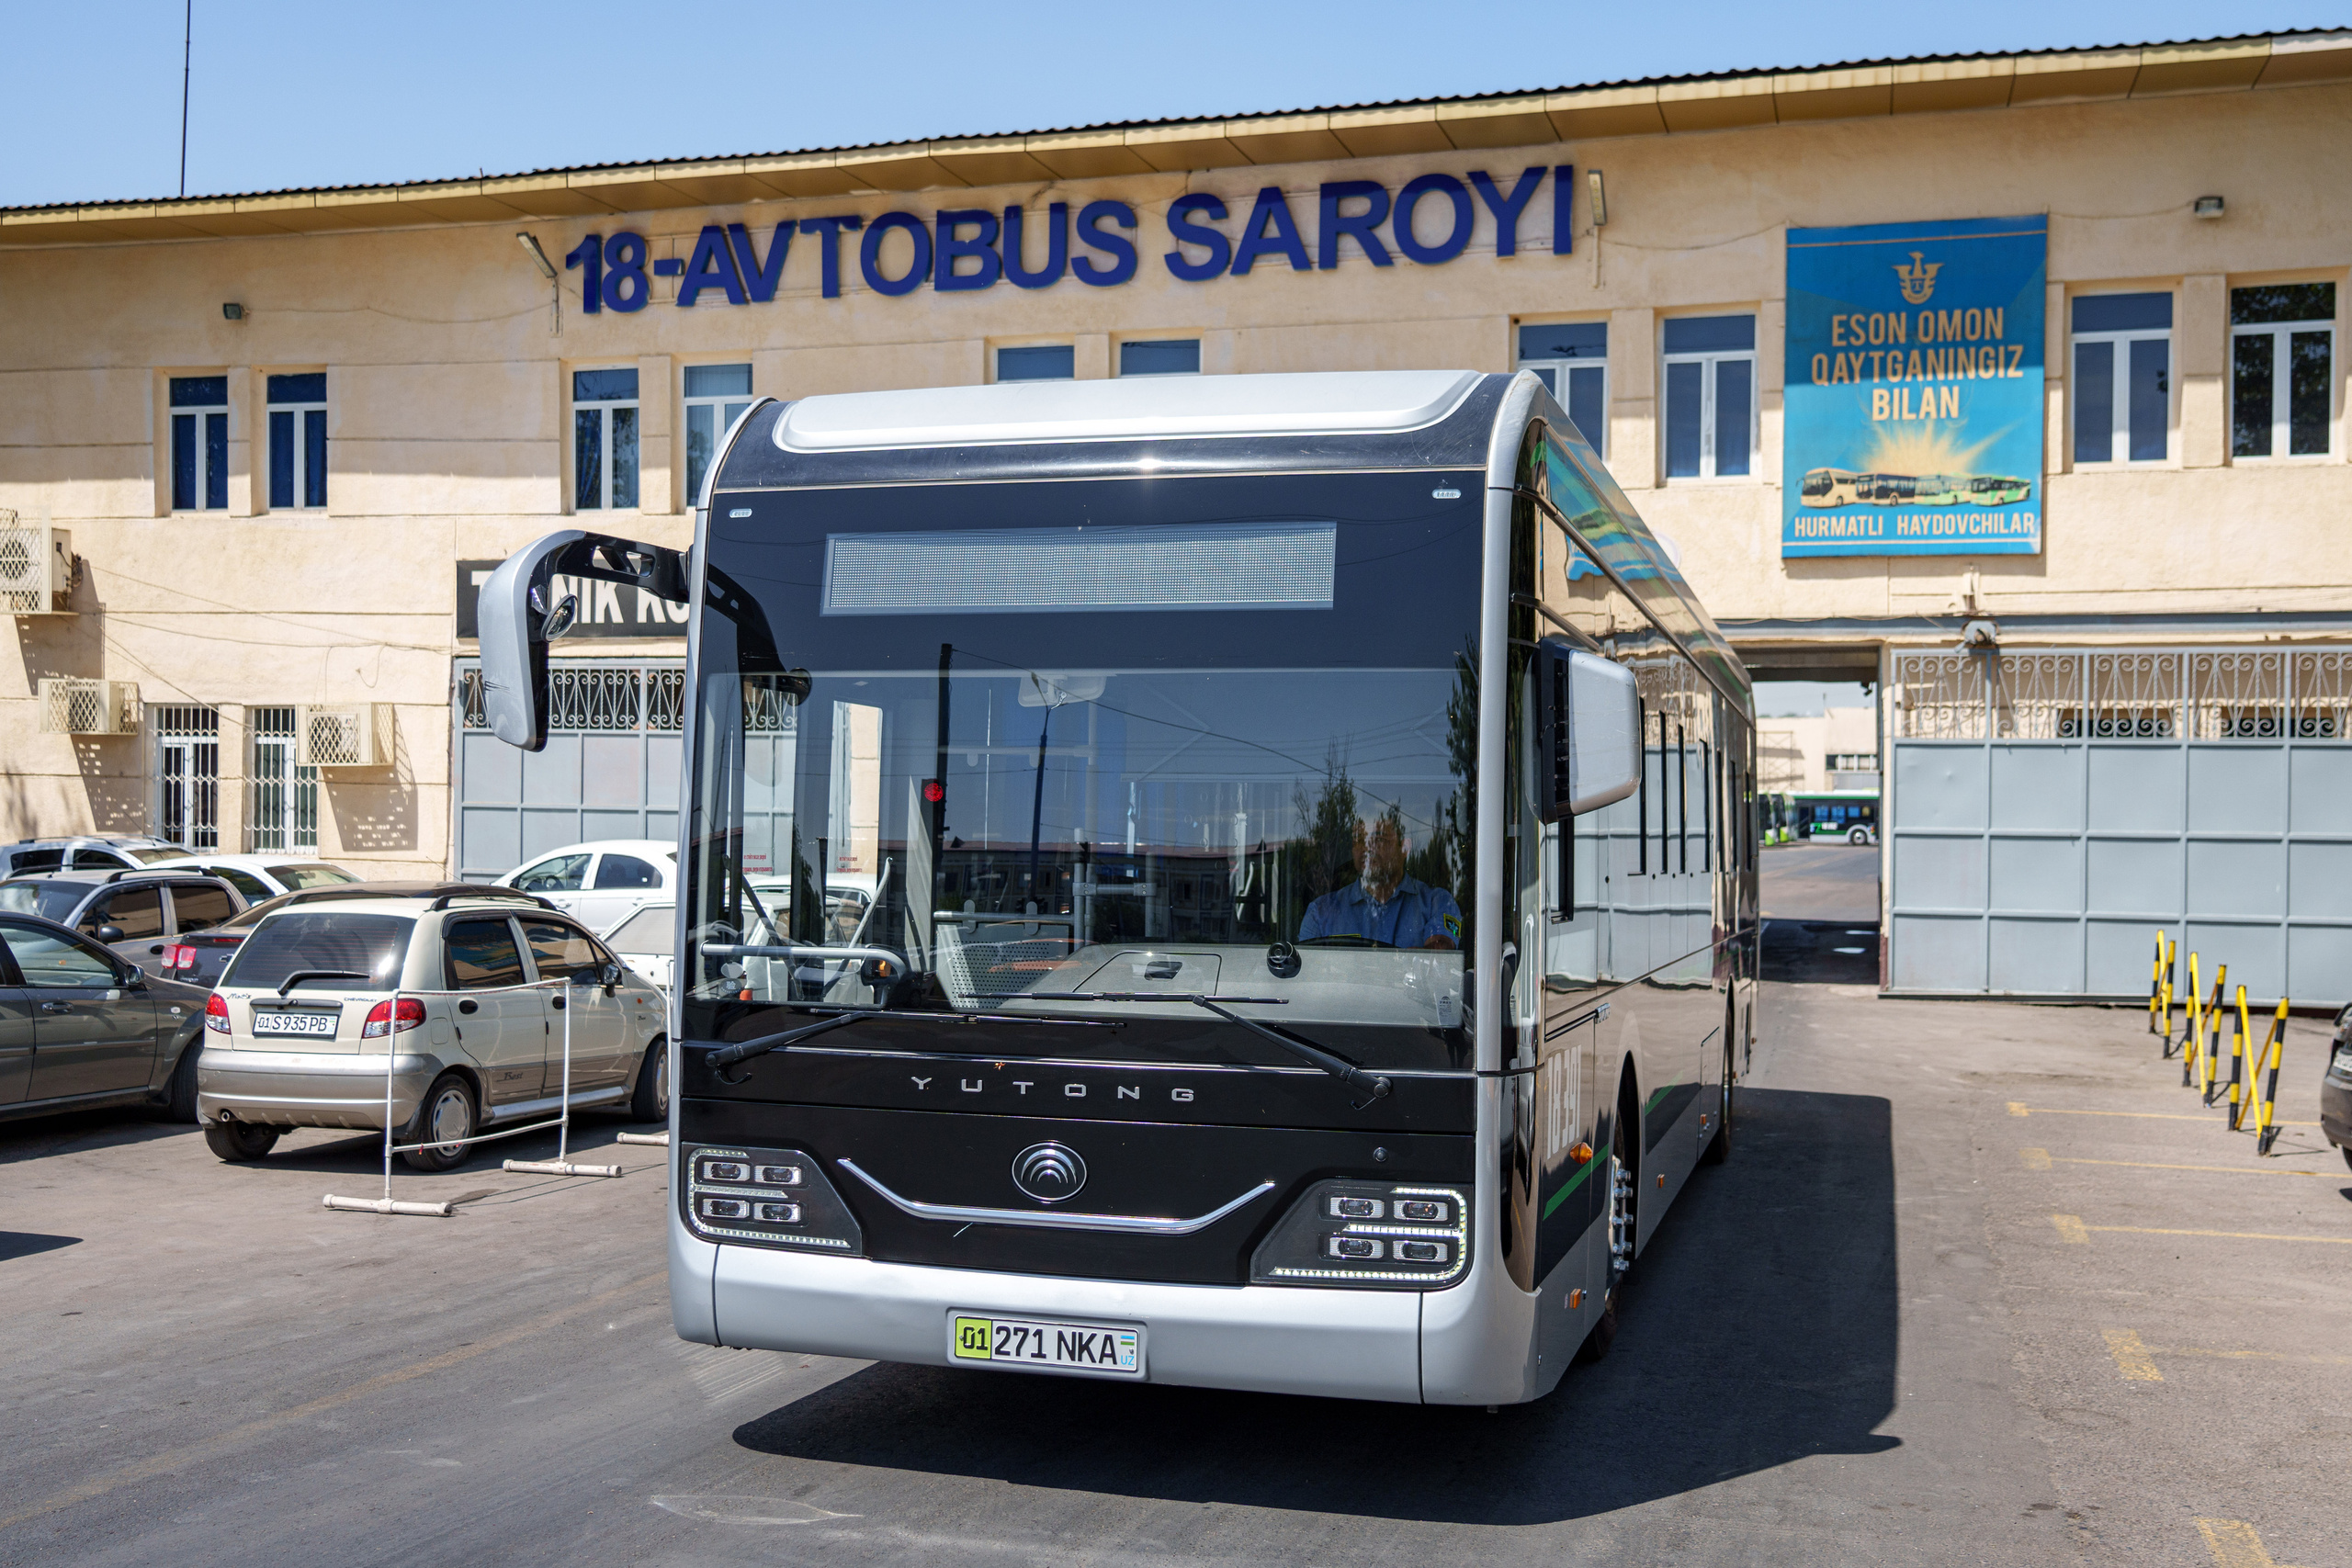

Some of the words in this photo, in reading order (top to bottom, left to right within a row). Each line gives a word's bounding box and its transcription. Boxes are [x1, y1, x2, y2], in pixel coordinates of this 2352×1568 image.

[564, 200, 1138, 315] 18-AVTOBUS
[1163, 163, 1575, 284] SAROYI
[1832, 311, 1906, 346] ESON
[1918, 307, 2004, 344] OMON
[1811, 344, 2024, 386] QAYTGANINGIZ
[1871, 386, 1960, 421] BILAN
[1794, 514, 1883, 537] HURMATLI
[1896, 512, 2035, 536] HAYDOVCHILAR
[910, 1076, 1194, 1102] YUTONG
[963, 1325, 989, 1351] 01
[1120, 1355, 1135, 1366] UZ
